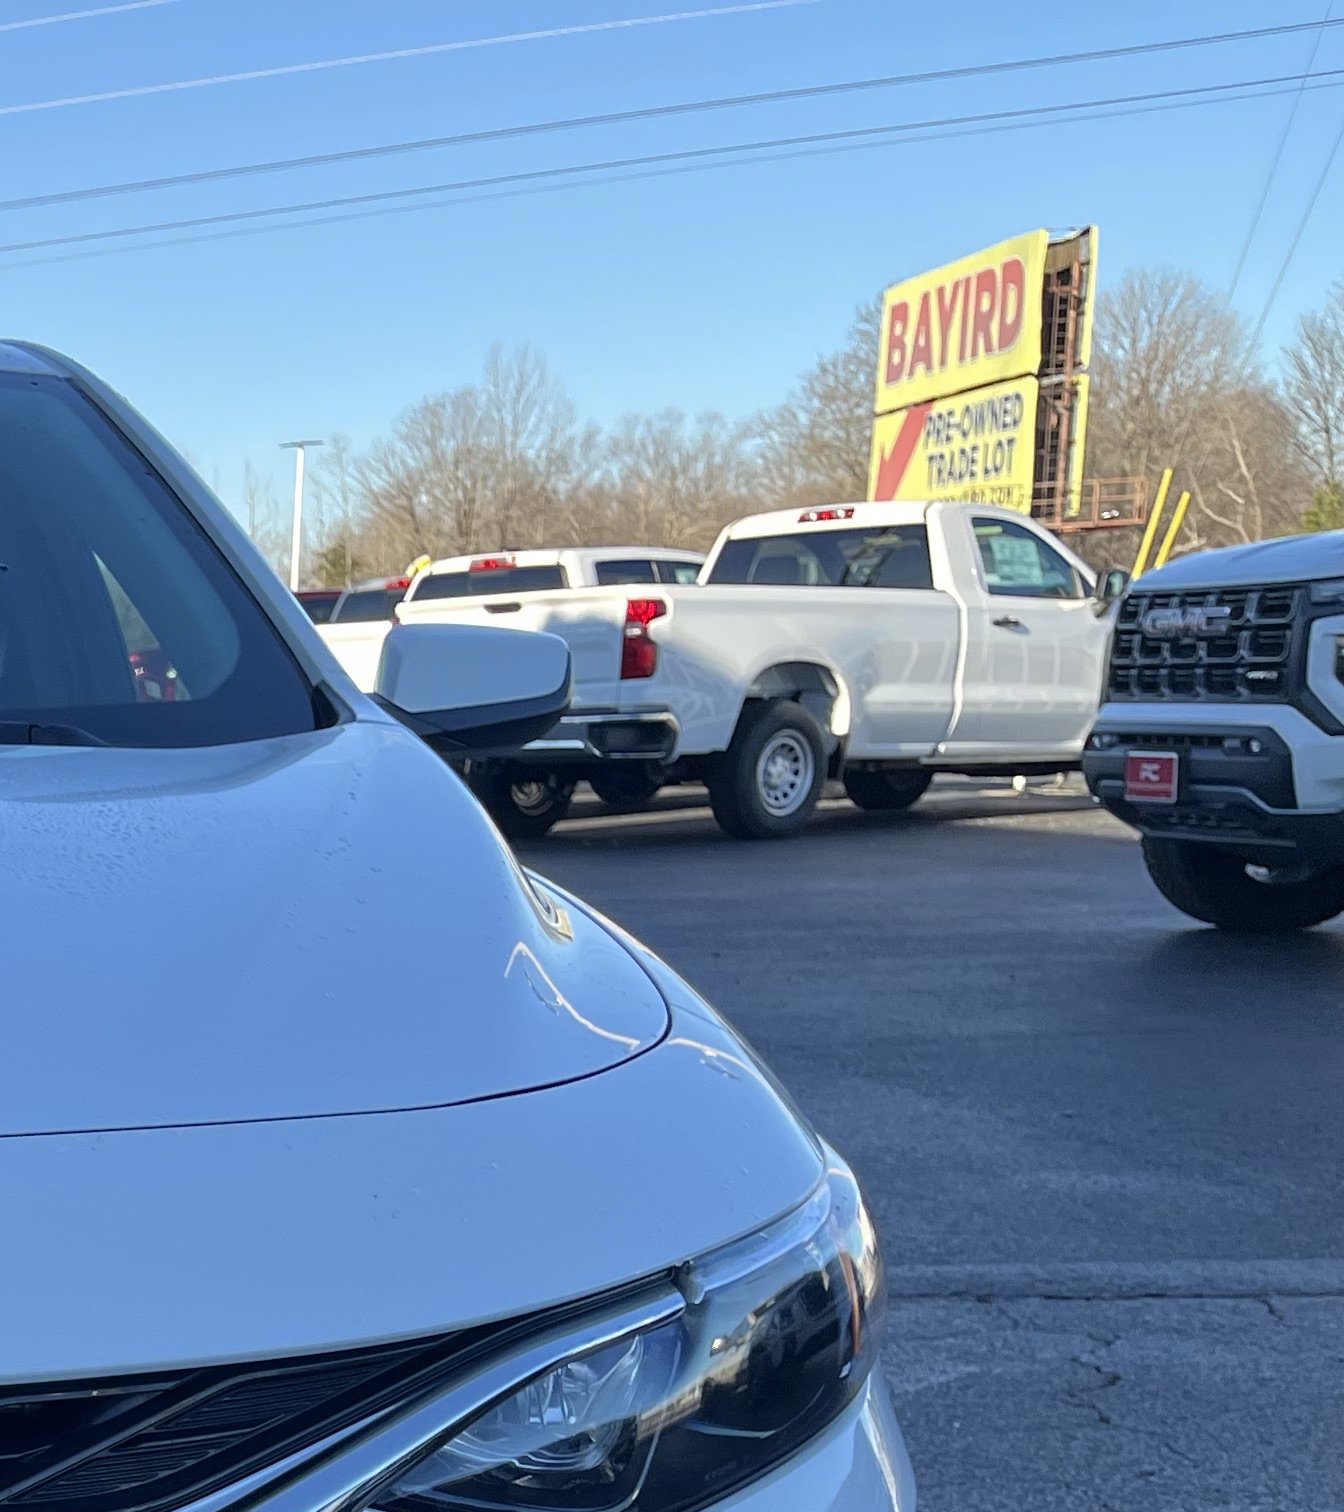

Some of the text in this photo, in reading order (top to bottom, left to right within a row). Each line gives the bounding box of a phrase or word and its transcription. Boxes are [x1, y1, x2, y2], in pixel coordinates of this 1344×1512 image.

[884, 257, 1026, 386] BAYIRD
[923, 391, 1024, 450] PRE-OWNED
[927, 437, 1017, 492] TRADE LOT
[1142, 605, 1233, 639] GMC
